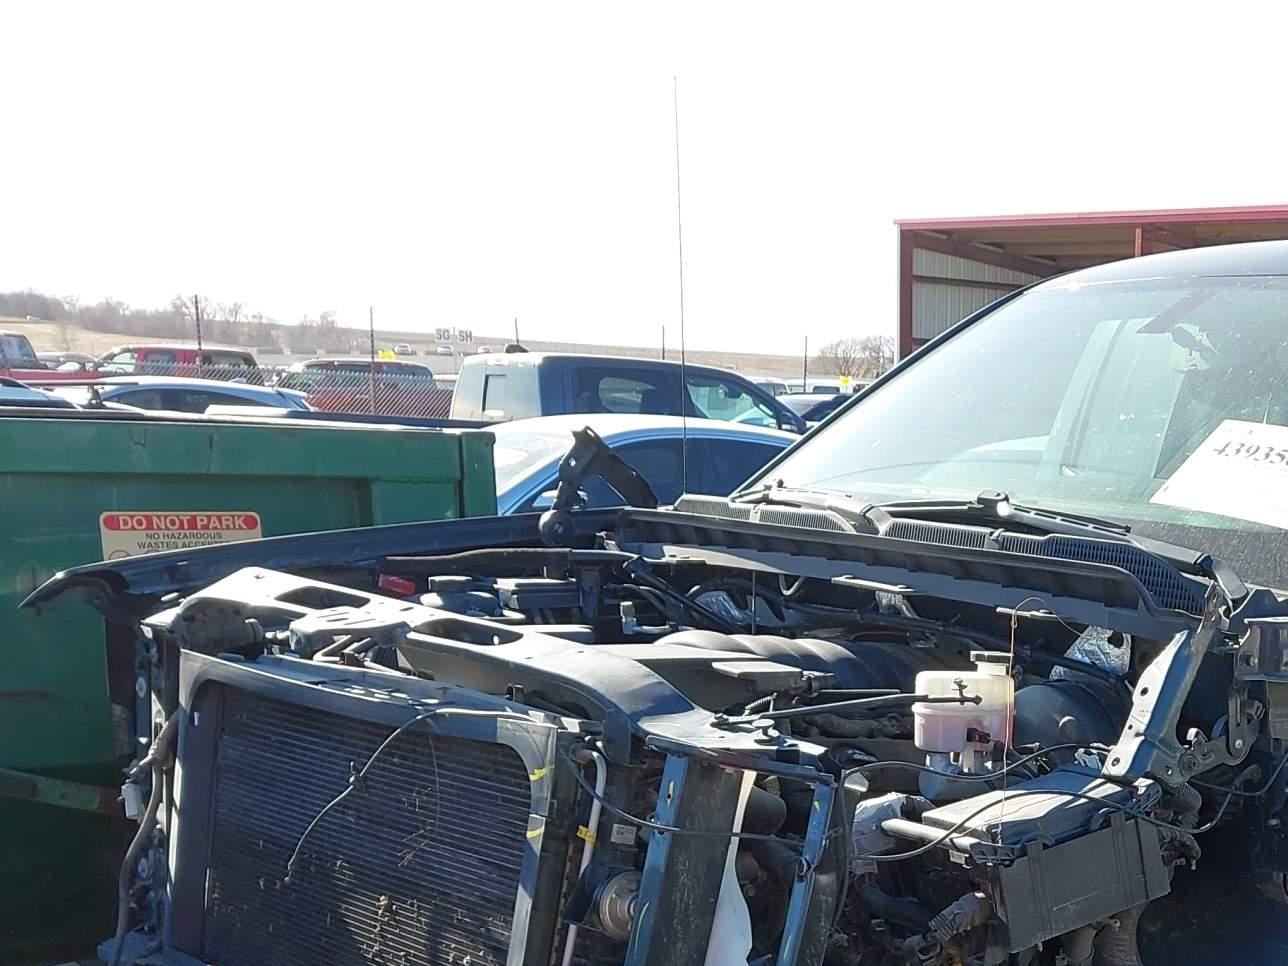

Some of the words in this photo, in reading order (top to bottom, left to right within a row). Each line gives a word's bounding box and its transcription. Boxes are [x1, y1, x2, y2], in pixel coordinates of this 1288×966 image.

[119, 515, 147, 530] DO
[152, 515, 191, 530] NOT
[196, 515, 247, 530] PARK
[145, 531, 160, 540] NO
[163, 531, 223, 540] HAZARDOUS
[137, 540, 179, 550] WASTES
